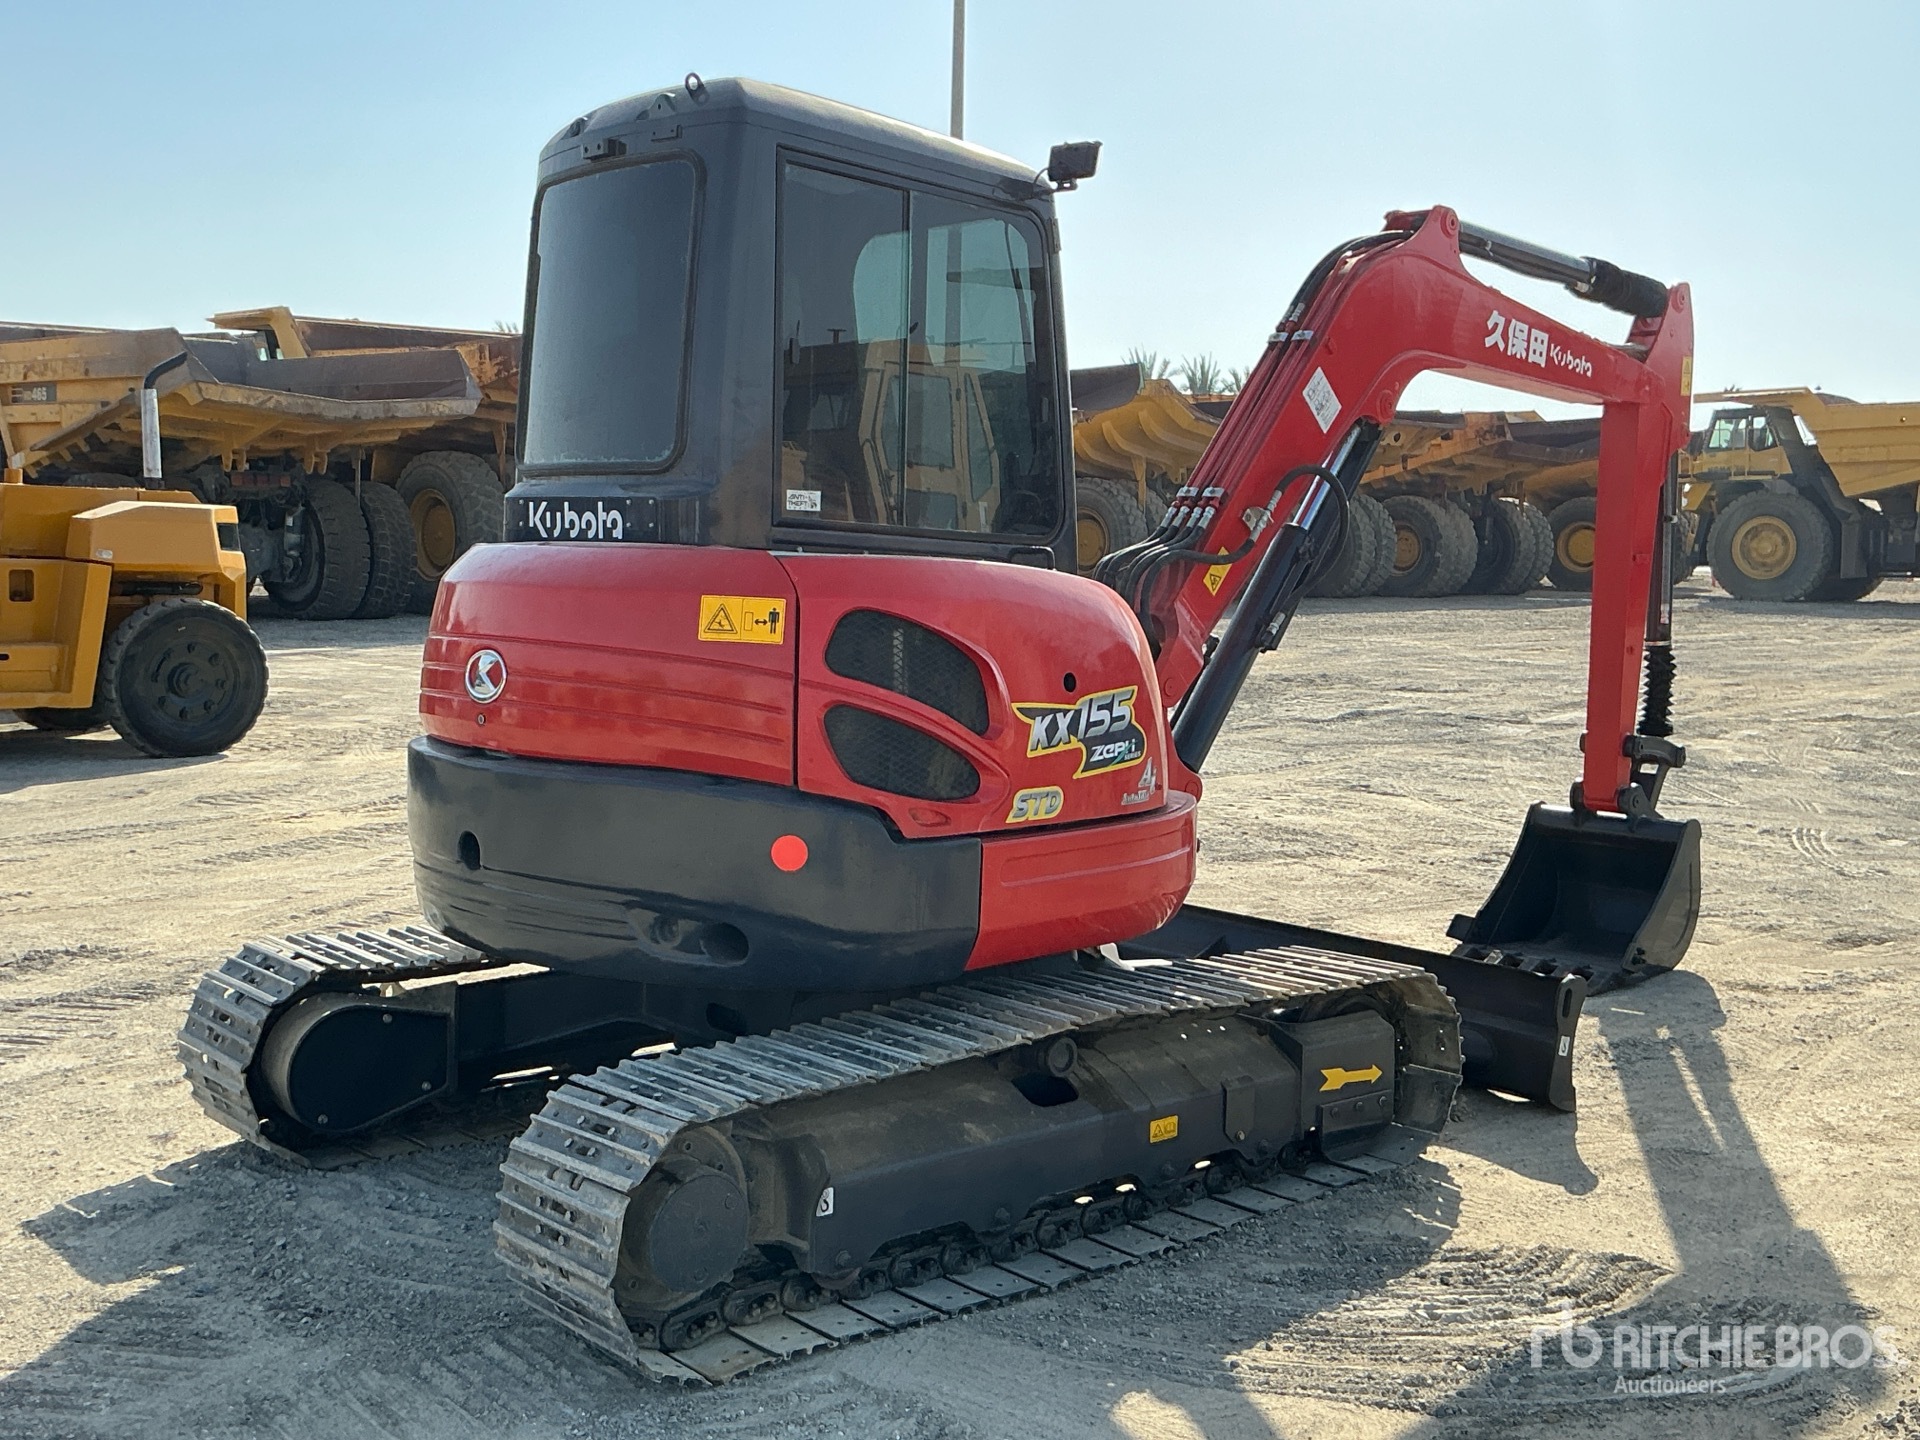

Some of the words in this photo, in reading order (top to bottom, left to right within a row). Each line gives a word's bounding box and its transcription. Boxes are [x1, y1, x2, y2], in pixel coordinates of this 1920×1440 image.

[1484, 309, 1549, 368] 久保田
[1549, 343, 1592, 378] Kubota
[528, 501, 624, 540] Kubota
[1012, 789, 1062, 819] STD
